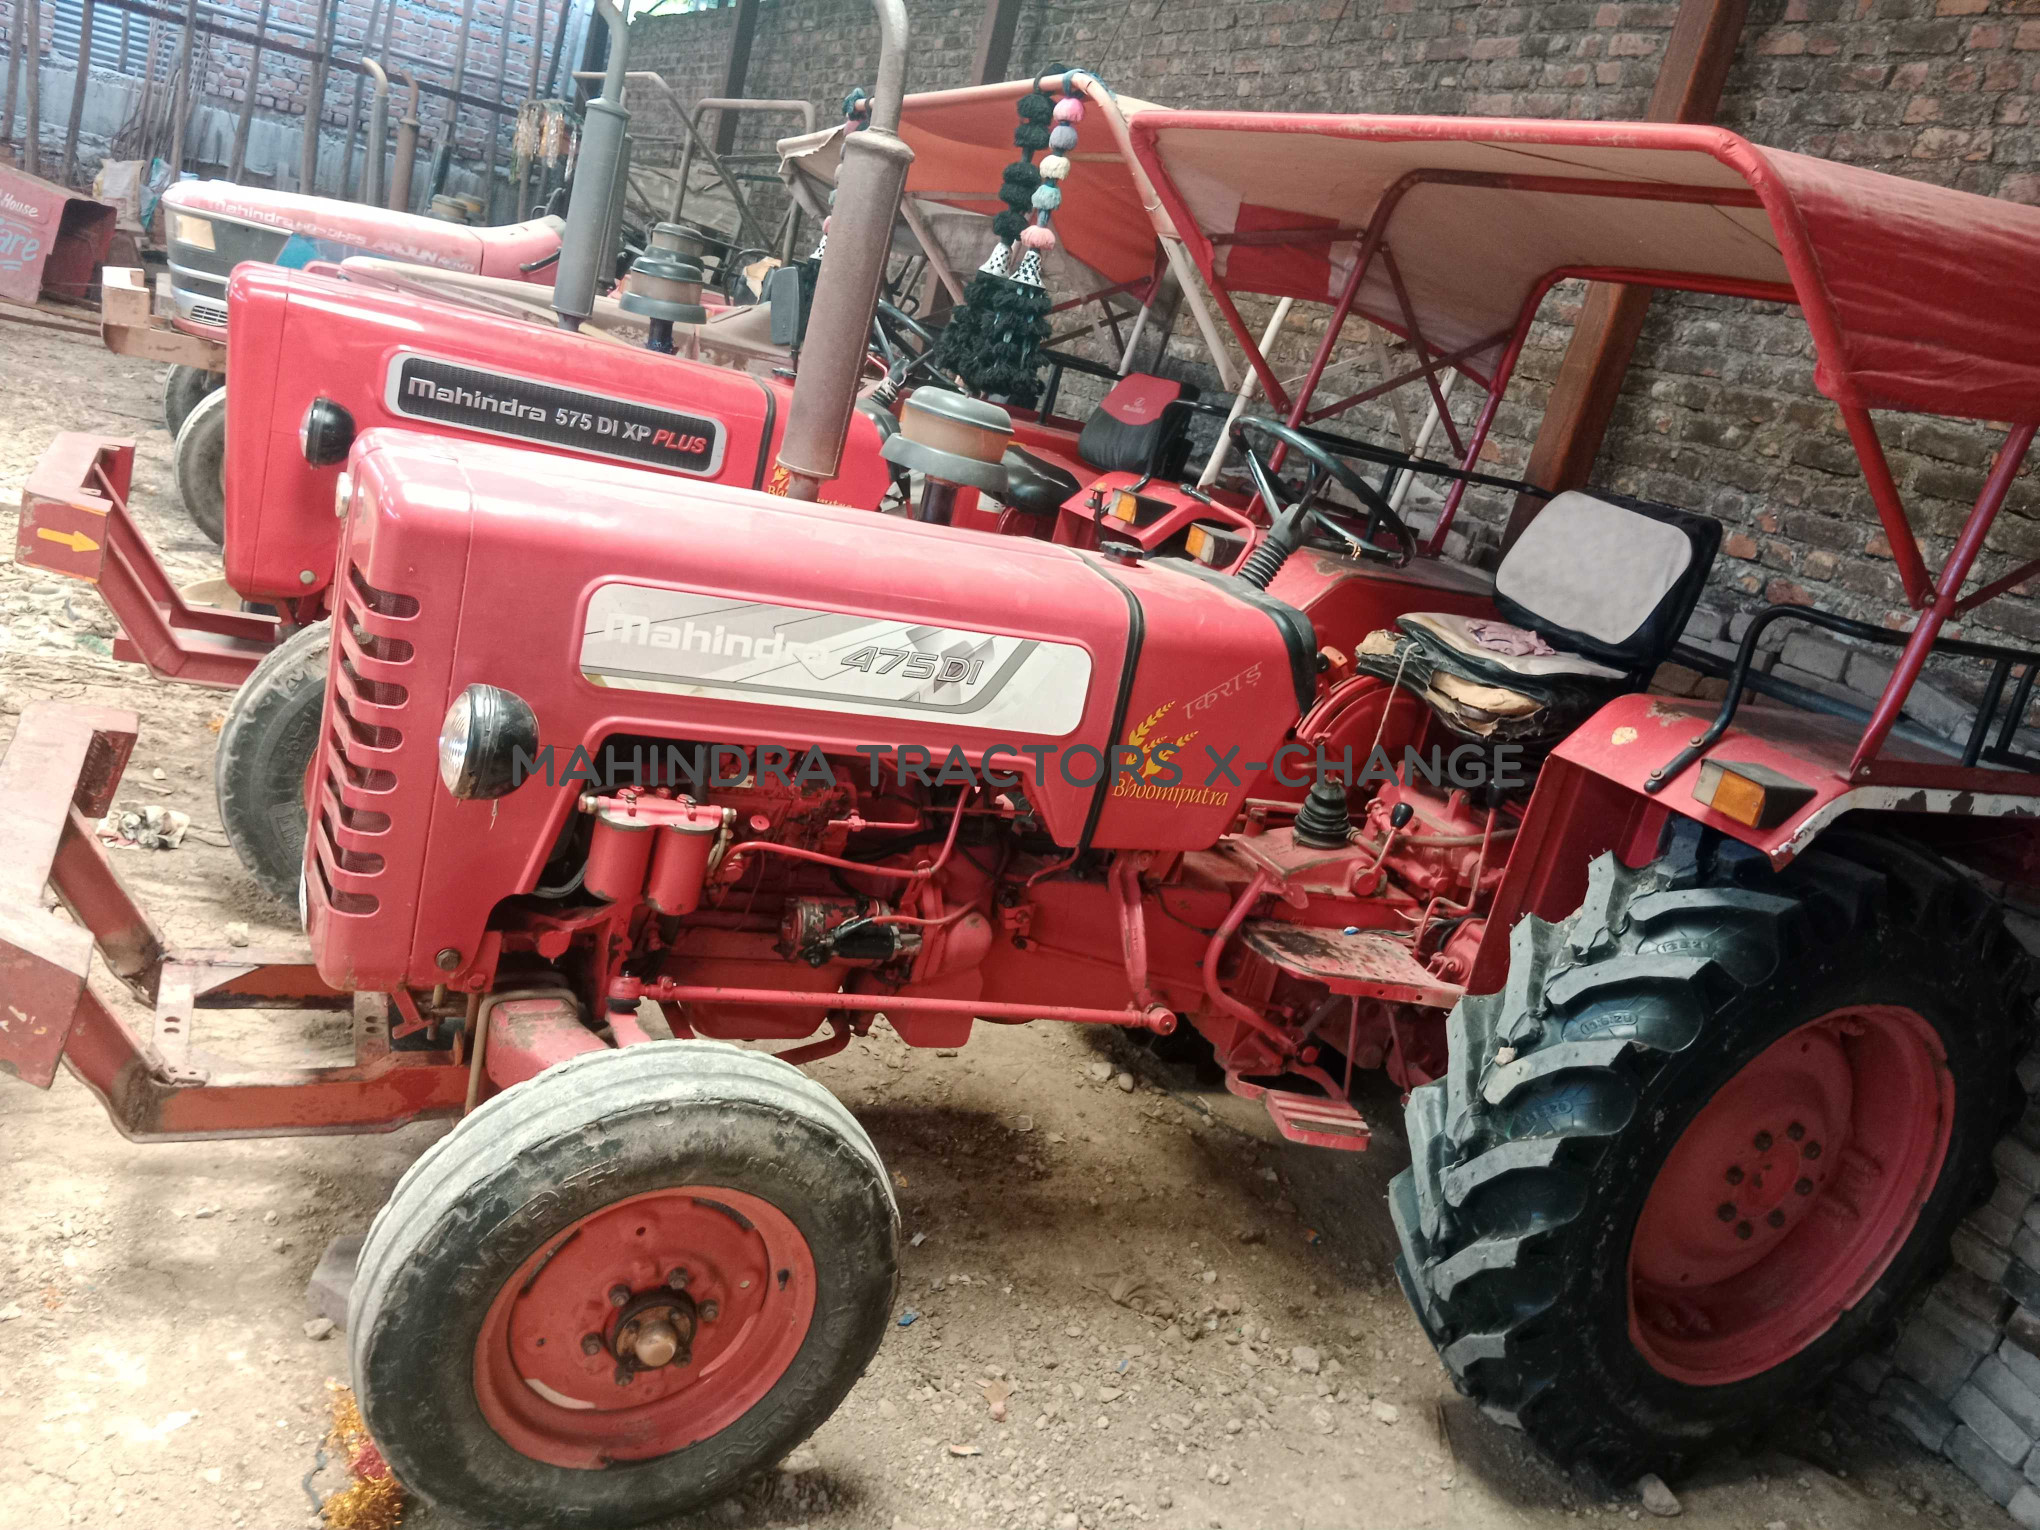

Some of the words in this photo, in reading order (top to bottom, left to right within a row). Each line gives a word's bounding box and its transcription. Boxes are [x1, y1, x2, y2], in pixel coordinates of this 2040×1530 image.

[1, 192, 39, 217] House
[206, 200, 293, 228] Mahindra
[0, 229, 40, 262] are
[408, 376, 547, 423] Mahindra
[555, 407, 592, 432] 575
[597, 416, 618, 437] DI
[622, 421, 651, 442] XP
[652, 428, 707, 454] PLUS
[603, 612, 829, 666] Mahindra
[1112, 778, 1229, 809] Bhoomiputra
